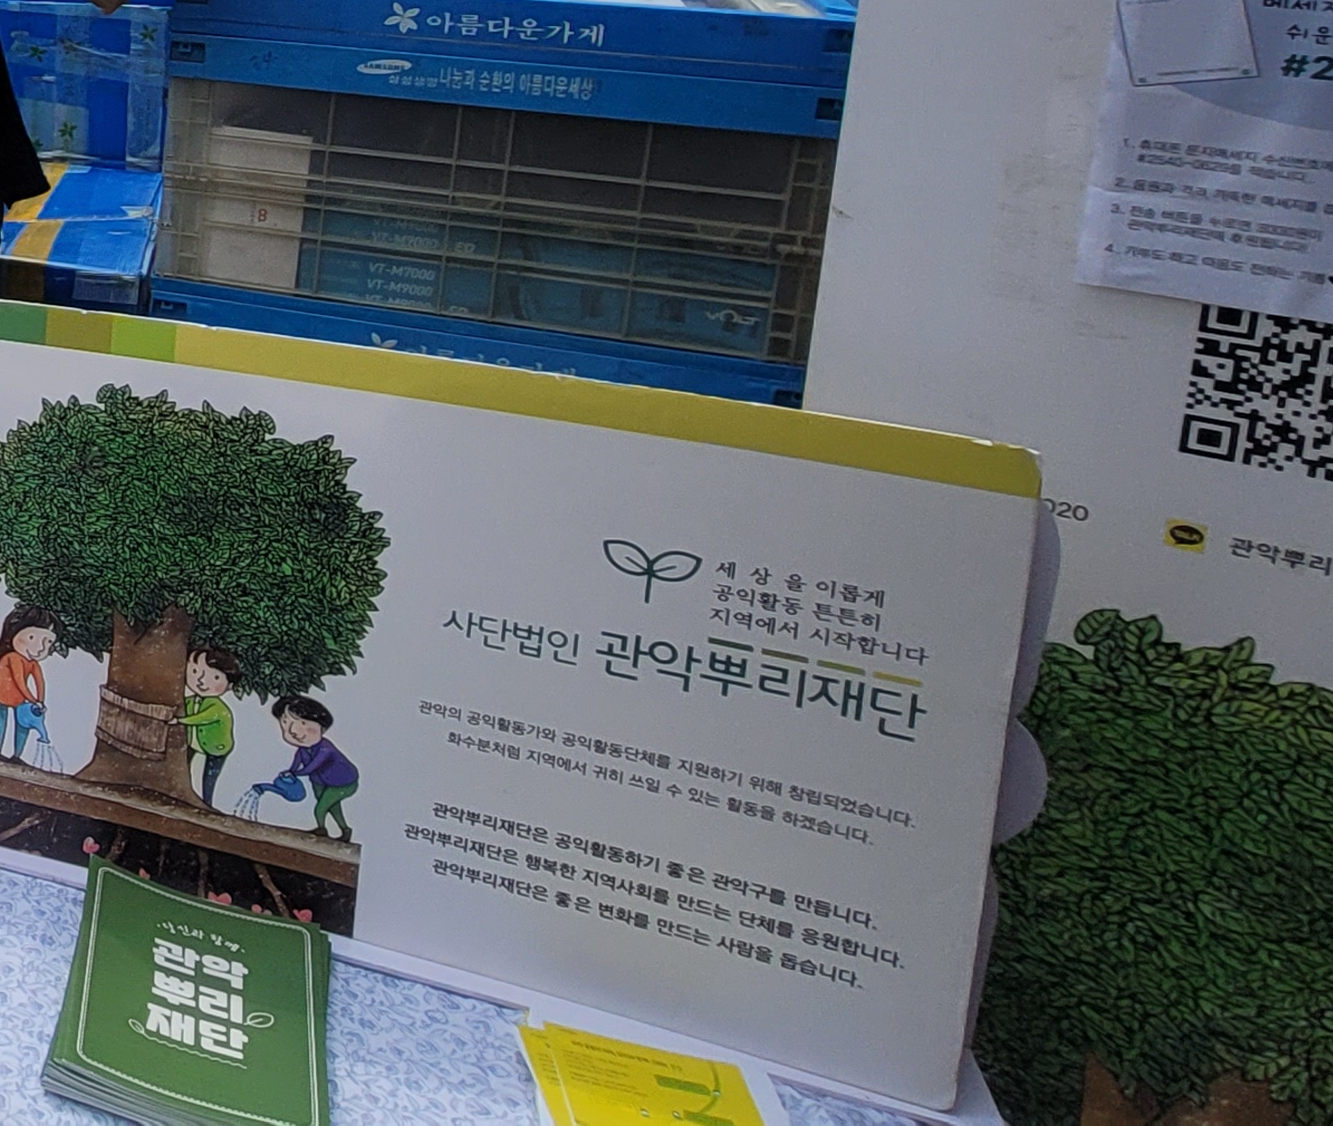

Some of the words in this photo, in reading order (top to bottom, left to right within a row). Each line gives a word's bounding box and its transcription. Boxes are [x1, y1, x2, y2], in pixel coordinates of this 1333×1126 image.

[426, 11, 605, 47] 아름다운가게
[519, 73, 593, 100] 아름다운세상
[367, 277, 434, 297] VT-M9000
[369, 261, 435, 281] VT-M7000
[712, 582, 804, 616] 공익활동
[816, 579, 886, 610] 이롭게
[709, 608, 800, 641] 지역에서
[808, 622, 930, 667] 시작합니다
[442, 609, 581, 667] 사단법인
[595, 629, 929, 744] 관악뿌리재단
[419, 699, 462, 722] 관악의
[466, 710, 557, 744] 공익활동가와
[561, 731, 672, 770] 공익활동단체를
[677, 758, 744, 787] 지원하기
[748, 775, 783, 796] 위해
[788, 785, 916, 829] 창립되었습니다.
[447, 731, 521, 761] 화수분처럼
[526, 749, 587, 776] 지역에서
[592, 763, 625, 785] 귀히
[628, 772, 661, 795] 쓰일
[665, 782, 683, 799] 수
[688, 786, 721, 808] 있는
[726, 796, 776, 823] 활동을
[781, 810, 874, 846] 하겠습니다.
[432, 801, 550, 844] 관악뿌리재단은
[554, 832, 661, 874] 공익활동하기
[666, 860, 706, 886] 좋은
[711, 872, 787, 907] 관악구를
[793, 893, 878, 932] 만듭니다.
[403, 823, 519, 867] 관악뿌리재단은
[524, 852, 578, 882] 행복한
[582, 868, 671, 907] 지역사회를
[676, 892, 732, 922] 만드는
[738, 909, 795, 940] 단체를
[800, 926, 906, 970] 응원합니다.
[432, 858, 549, 903] 관악뿌리재단은
[554, 890, 592, 917] 좋은
[596, 901, 651, 932] 변화를
[655, 917, 712, 947] 만드는
[716, 935, 774, 966] 사람을
[779, 951, 864, 990] 돕습니다.
[152, 937, 249, 990] 관악
[151, 970, 244, 1025] 뿌리
[146, 1002, 249, 1060] 재단
